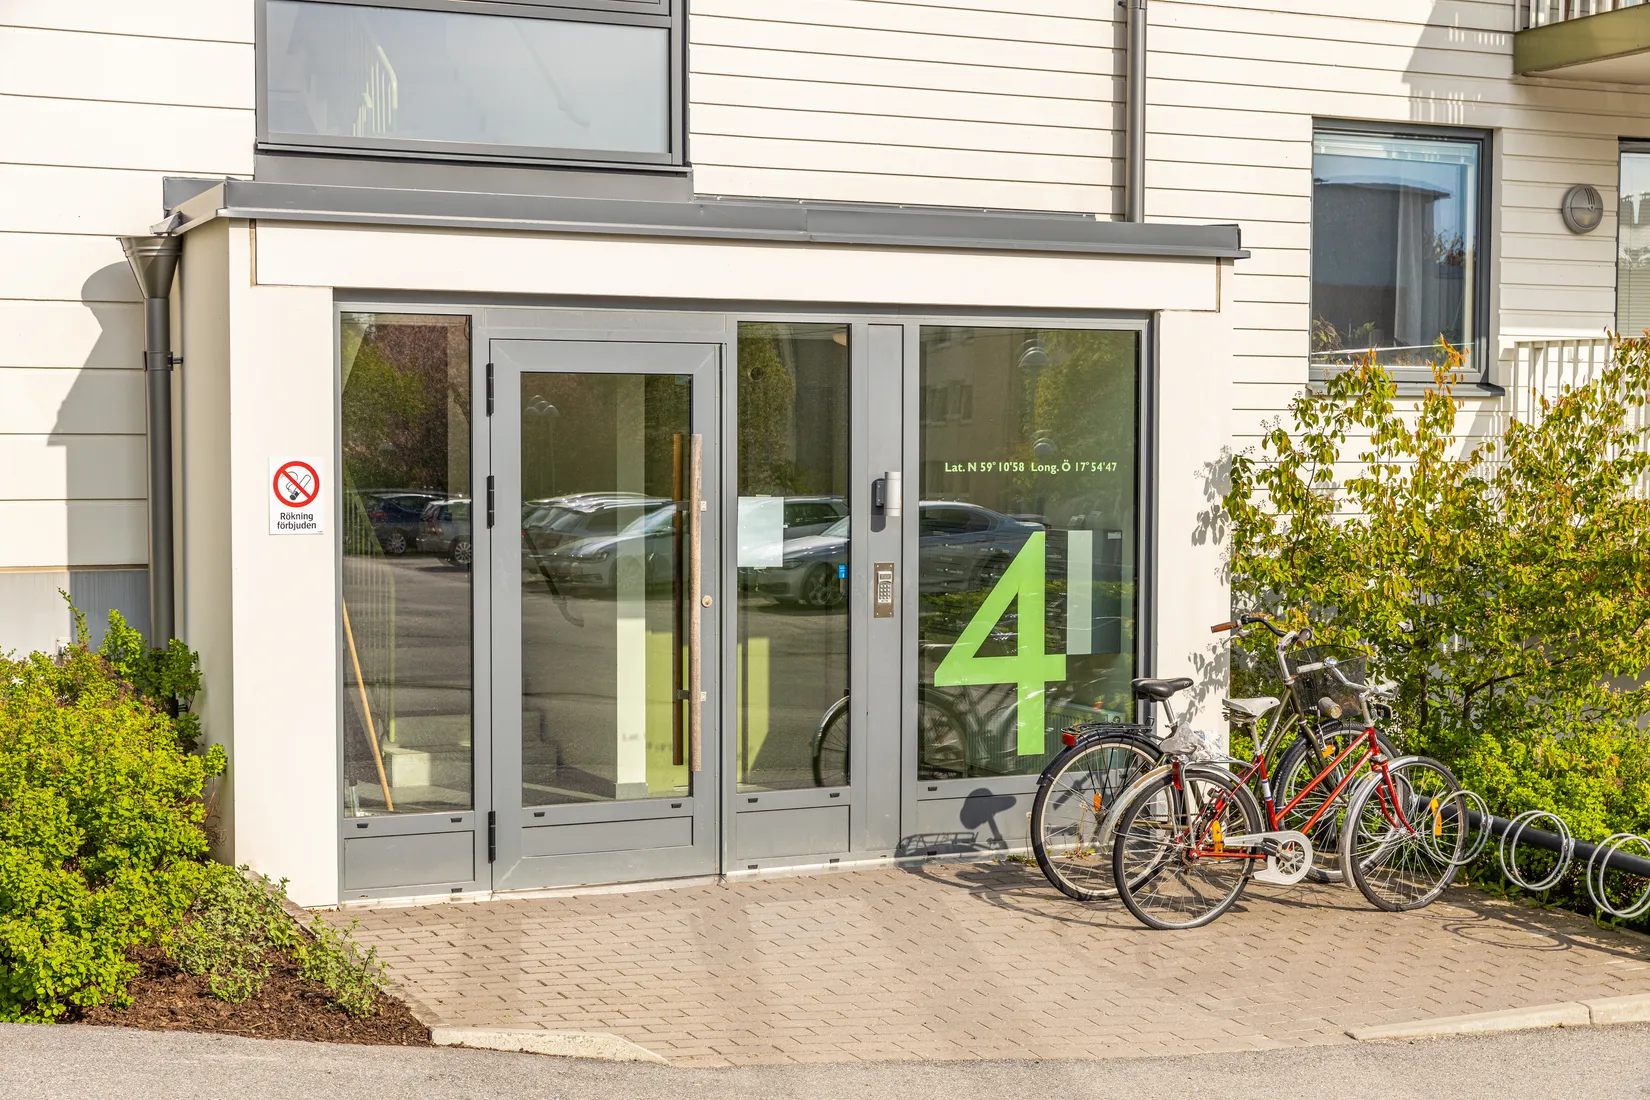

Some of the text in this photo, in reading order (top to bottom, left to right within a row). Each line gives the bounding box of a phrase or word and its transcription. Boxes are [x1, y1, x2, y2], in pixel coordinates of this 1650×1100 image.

[944, 462, 966, 472] Lat.
[967, 462, 977, 472] N
[1031, 462, 1060, 475] Long.
[1061, 459, 1072, 472] Ö
[280, 512, 314, 521] Rökning
[277, 521, 317, 531] förbjuden
[934, 531, 1067, 756] 4
